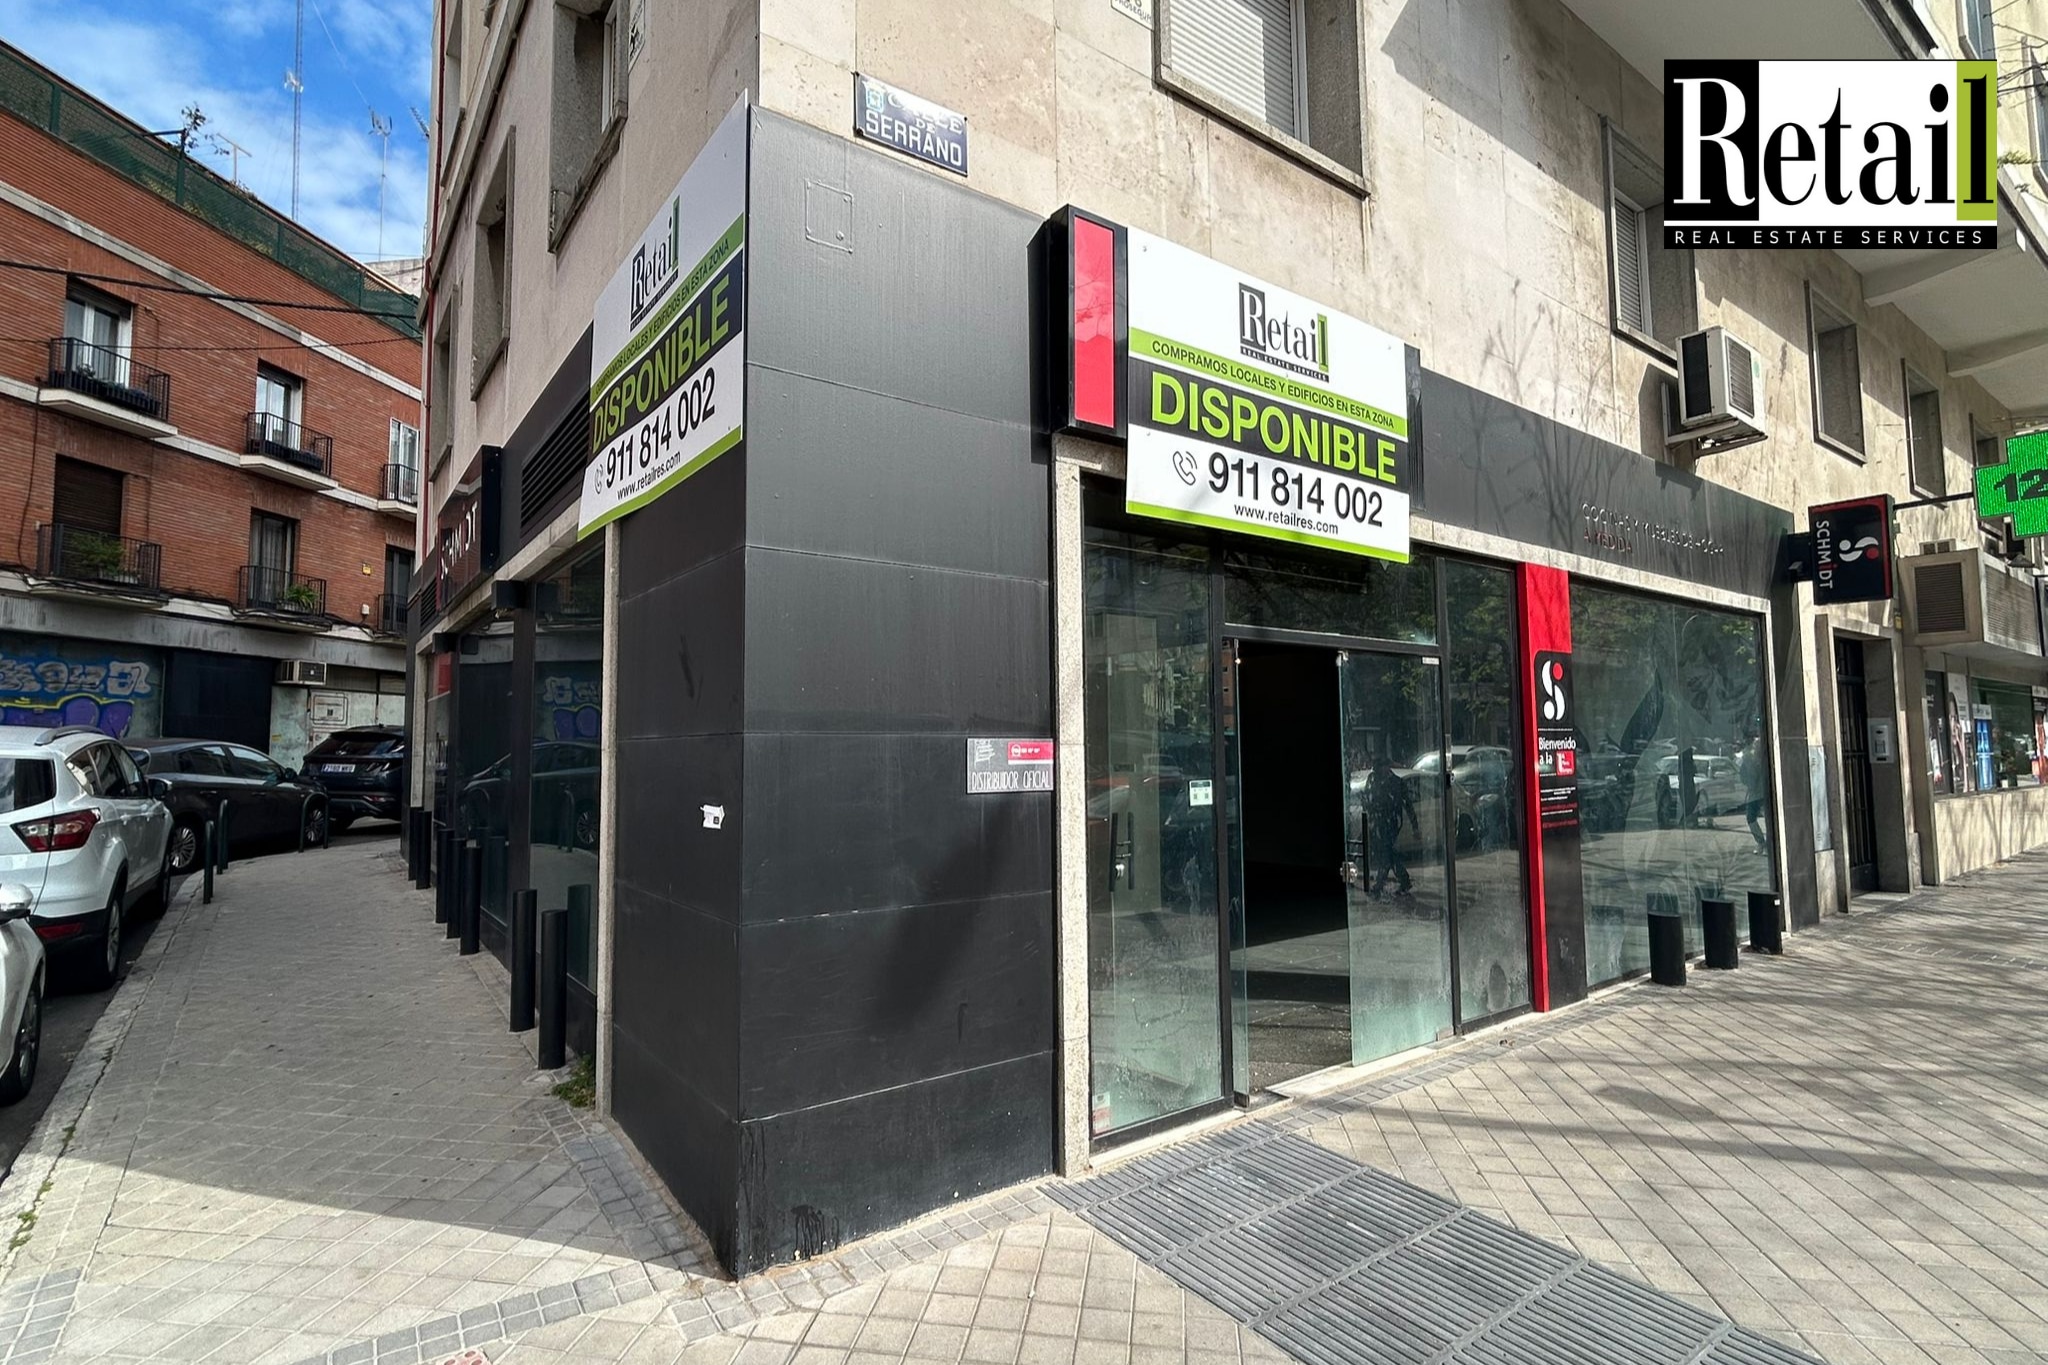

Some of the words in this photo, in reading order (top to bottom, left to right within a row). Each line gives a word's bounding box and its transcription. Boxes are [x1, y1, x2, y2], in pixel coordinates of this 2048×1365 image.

[866, 109, 962, 167] SERRANO
[887, 91, 963, 134] CLLE
[916, 118, 937, 134] DE
[632, 203, 679, 314] Retail
[623, 331, 648, 363] LOCALES
[653, 293, 681, 335] EDIFICIOS
[681, 284, 690, 302] EN
[691, 264, 708, 291] ESTA
[709, 238, 730, 271] ZONA
[1240, 288, 1328, 368] Retail
[593, 273, 730, 454] DISPONIBLE
[1152, 340, 1228, 375] COMPRAMOS
[1231, 364, 1276, 391] LOCALES
[1279, 377, 1288, 393] Y
[1288, 379, 1334, 408] EDIFICIOS
[1336, 396, 1349, 412] EN
[1350, 400, 1371, 420] ESTA
[1373, 407, 1394, 428] ZONA
[606, 434, 633, 488] 911
[639, 405, 672, 469] 814
[677, 367, 715, 440] 002
[1151, 371, 1397, 484] DISPONIBLE
[617, 451, 681, 500] www.retailres.com
[1208, 452, 1259, 501] 911
[1270, 467, 1325, 514] 814
[1334, 482, 1383, 527] 002
[1234, 503, 1339, 535] www.retailres.com
[1538, 736, 1576, 750] Bienvenido
[1539, 754, 1544, 765] a
[1545, 751, 1553, 765] la
[1023, 770, 1050, 789] OFICIAL
